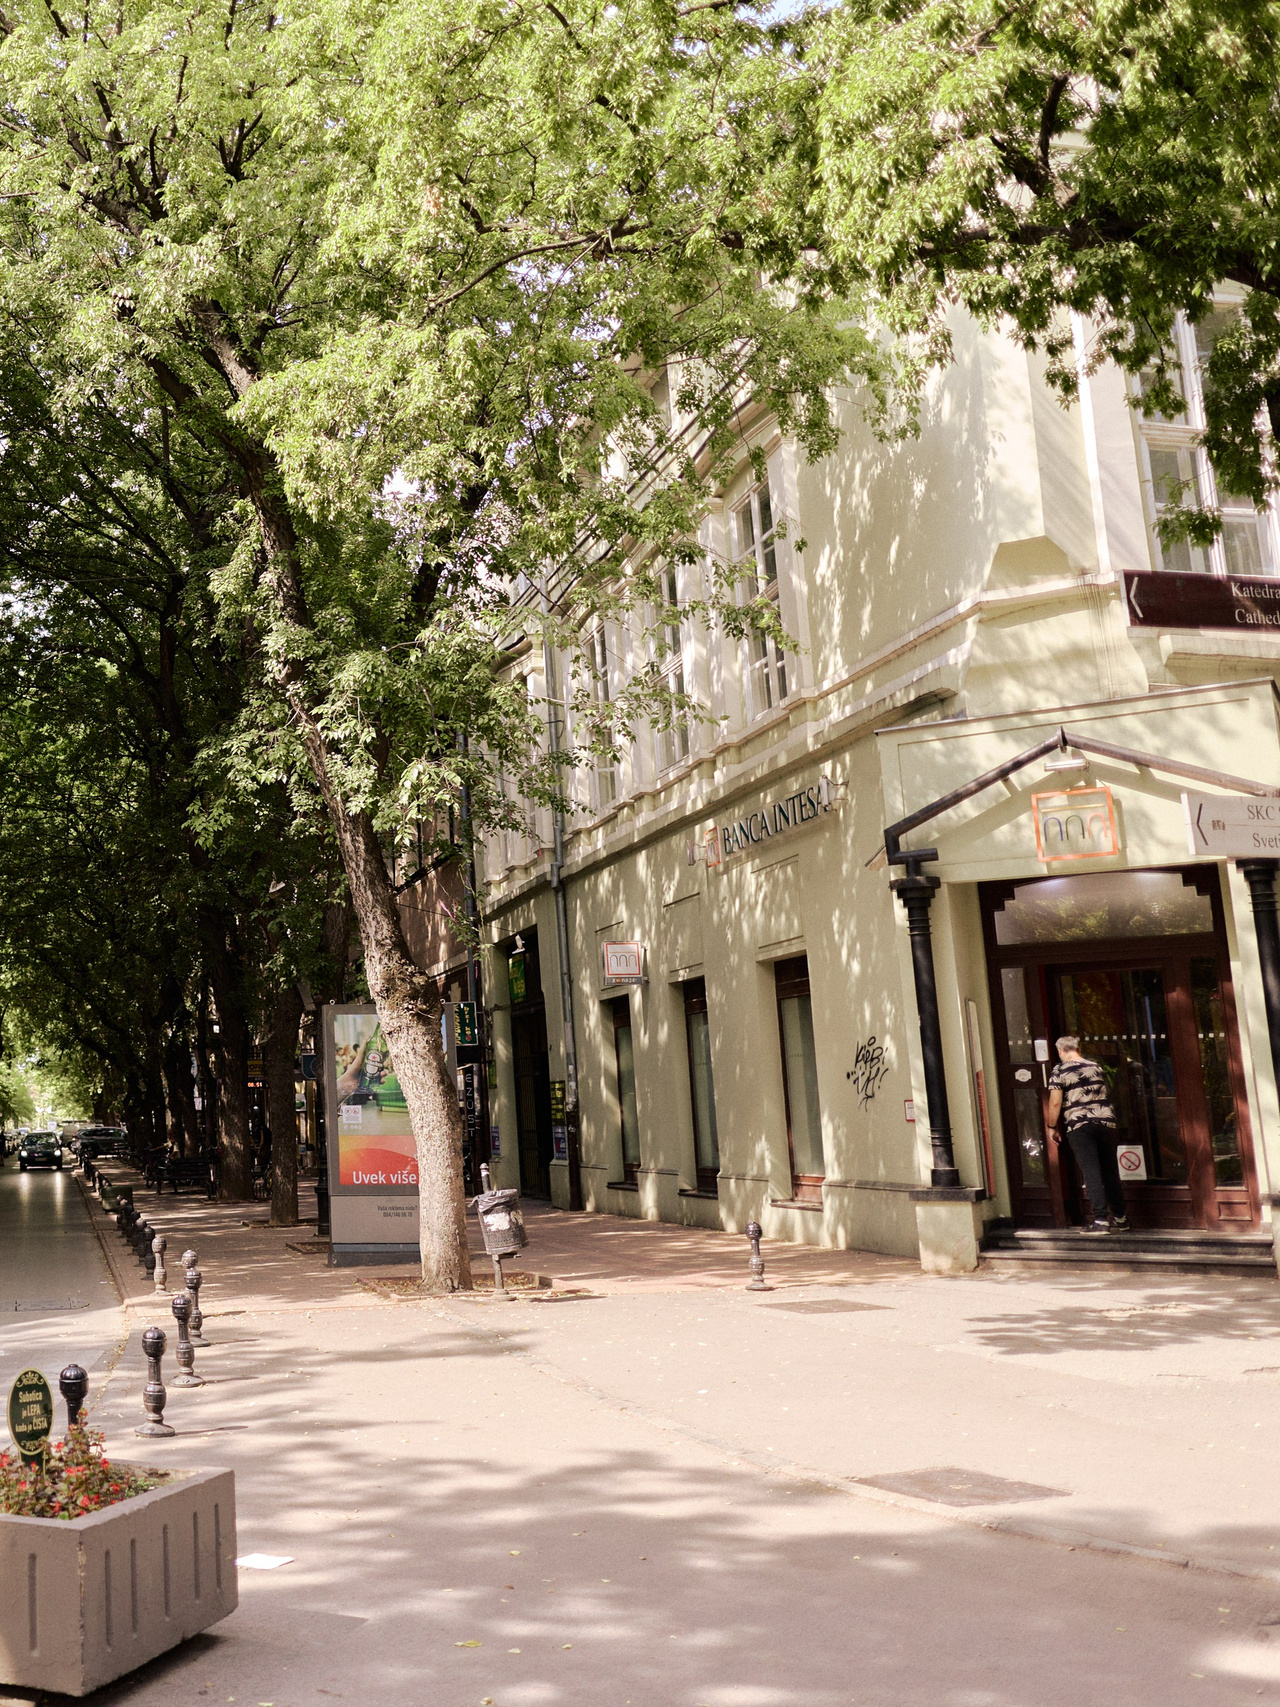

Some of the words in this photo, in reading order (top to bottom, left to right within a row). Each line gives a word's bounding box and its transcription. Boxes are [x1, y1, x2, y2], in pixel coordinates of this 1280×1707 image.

[1247, 804, 1275, 820] SKC
[722, 810, 772, 855] BANCA
[352, 1171, 387, 1185] Uvek
[390, 1170, 417, 1185] više
[19, 1390, 42, 1402] Subotica
[22, 1408, 27, 1419] je
[27, 1404, 40, 1416] LEPA
[33, 1417, 48, 1430] ČISTA
